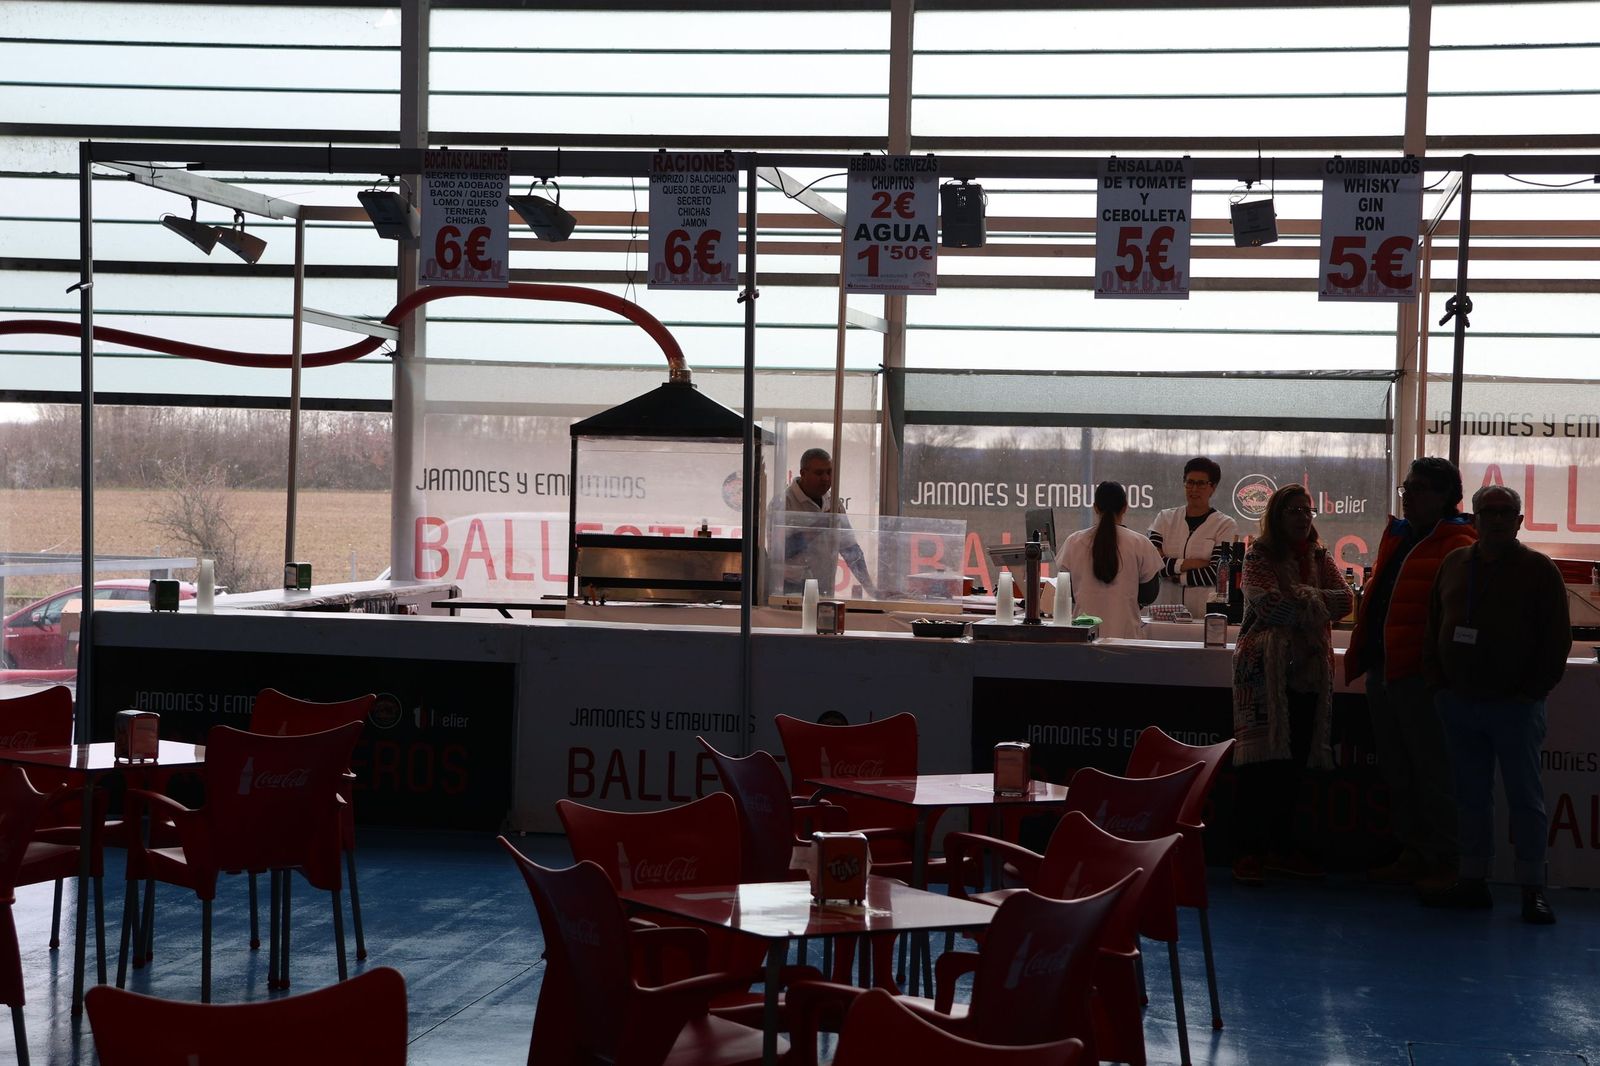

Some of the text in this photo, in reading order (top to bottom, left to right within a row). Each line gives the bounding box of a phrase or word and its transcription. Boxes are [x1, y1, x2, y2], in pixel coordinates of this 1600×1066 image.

[424, 152, 508, 170] BOCATAS CALIENTES
[653, 154, 736, 172] RACIONES
[850, 158, 886, 172] BEBIDAS
[893, 158, 937, 172] CERVEZAS
[1107, 160, 1184, 173] ENSALADA
[1326, 159, 1420, 174] COMBINADOS
[425, 172, 468, 180] SECRETO
[651, 174, 684, 183] CHORIZO
[690, 174, 737, 184] SALCHICHON
[872, 176, 914, 190] CHUPITOS
[1104, 176, 1186, 189] DE TOMATE
[458, 182, 504, 190] ADOBADO
[662, 186, 726, 194] QUESO DE OVEJA
[1344, 178, 1400, 194] WHISKY
[430, 190, 462, 198] BACON
[470, 190, 501, 198] QUESO
[676, 196, 712, 206] SECRETO
[1140, 192, 1150, 205] Y
[433, 198, 460, 206] LOMO
[466, 200, 498, 208] QUESO
[870, 191, 916, 219] 2€
[1358, 197, 1383, 212] GIN
[444, 208, 488, 216] TERNERA
[678, 208, 710, 216] CHICHAS
[1102, 208, 1186, 222] CEBOLLETA
[446, 216, 486, 224] CHICHAS
[680, 218, 707, 227] JAMON
[1355, 216, 1384, 231] RON
[854, 223, 930, 242] AGUA
[435, 225, 492, 271] 6€
[664, 229, 722, 275] 6€
[1115, 226, 1175, 282] 5€
[1326, 236, 1414, 290] 5€
[416, 468, 646, 500] JAMONES Y EMUTIDOS
[910, 482, 1009, 507] JAMONES
[1016, 483, 1028, 508] Y
[130, 690, 204, 712] JAMONES
[208, 693, 218, 713] Y
[570, 708, 645, 728] JAMONES
[651, 711, 660, 730] Y
[1027, 724, 1102, 746] JAMONES
[1107, 728, 1118, 748] Y
